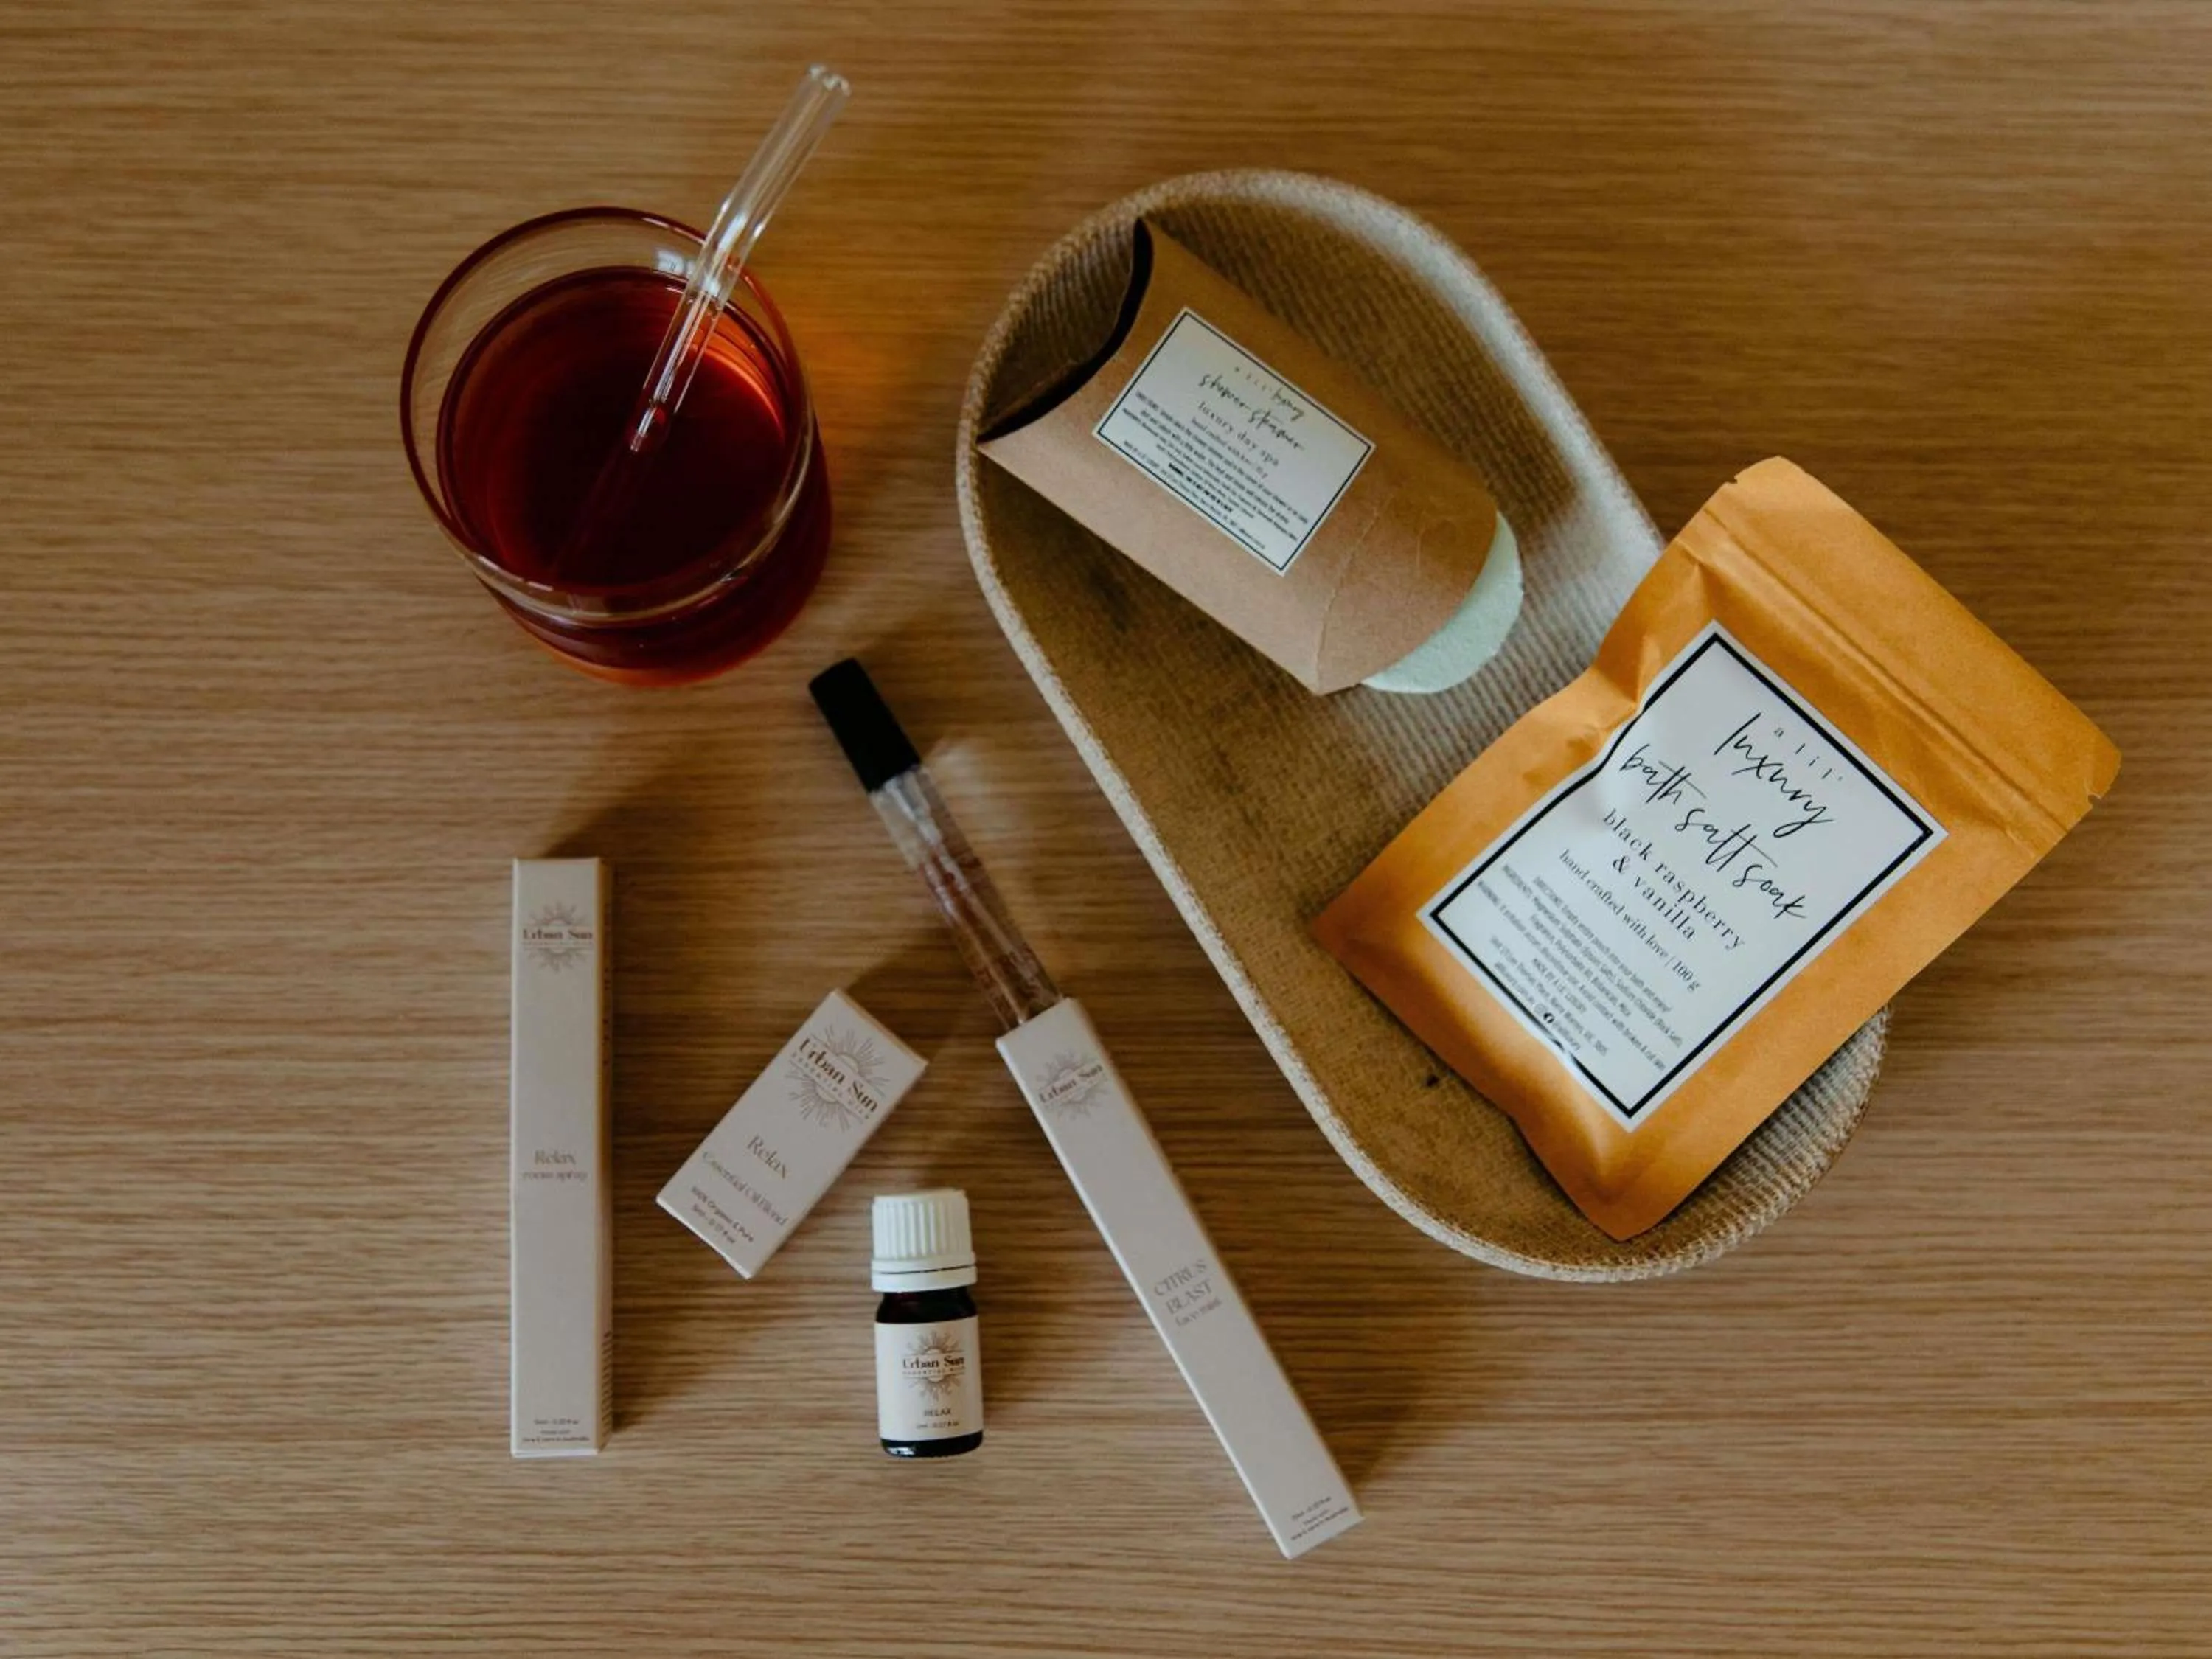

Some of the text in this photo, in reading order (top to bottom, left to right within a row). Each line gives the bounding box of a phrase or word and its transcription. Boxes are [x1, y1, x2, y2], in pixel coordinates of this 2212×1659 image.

[1197, 400, 1279, 467] luxury day spa
[1773, 727, 1784, 738] a
[1713, 712, 1834, 839] luxury
[1618, 743, 1806, 919] bath salt soak
[1602, 807, 1740, 950] black raspberry
[1612, 855, 1695, 940] & vanilla
[1559, 849, 1590, 880] hand
[1586, 879, 1626, 916] crafted
[1623, 914, 1647, 940] with
[1644, 933, 1669, 958] love
[1672, 961, 1694, 981] 100
[1686, 980, 1700, 992] g
[799, 1037, 878, 1113] Urban Sun
[746, 1135, 787, 1180] Relax
[1152, 1258, 1208, 1296] CITRUS
[1166, 1277, 1212, 1315] BLAST
